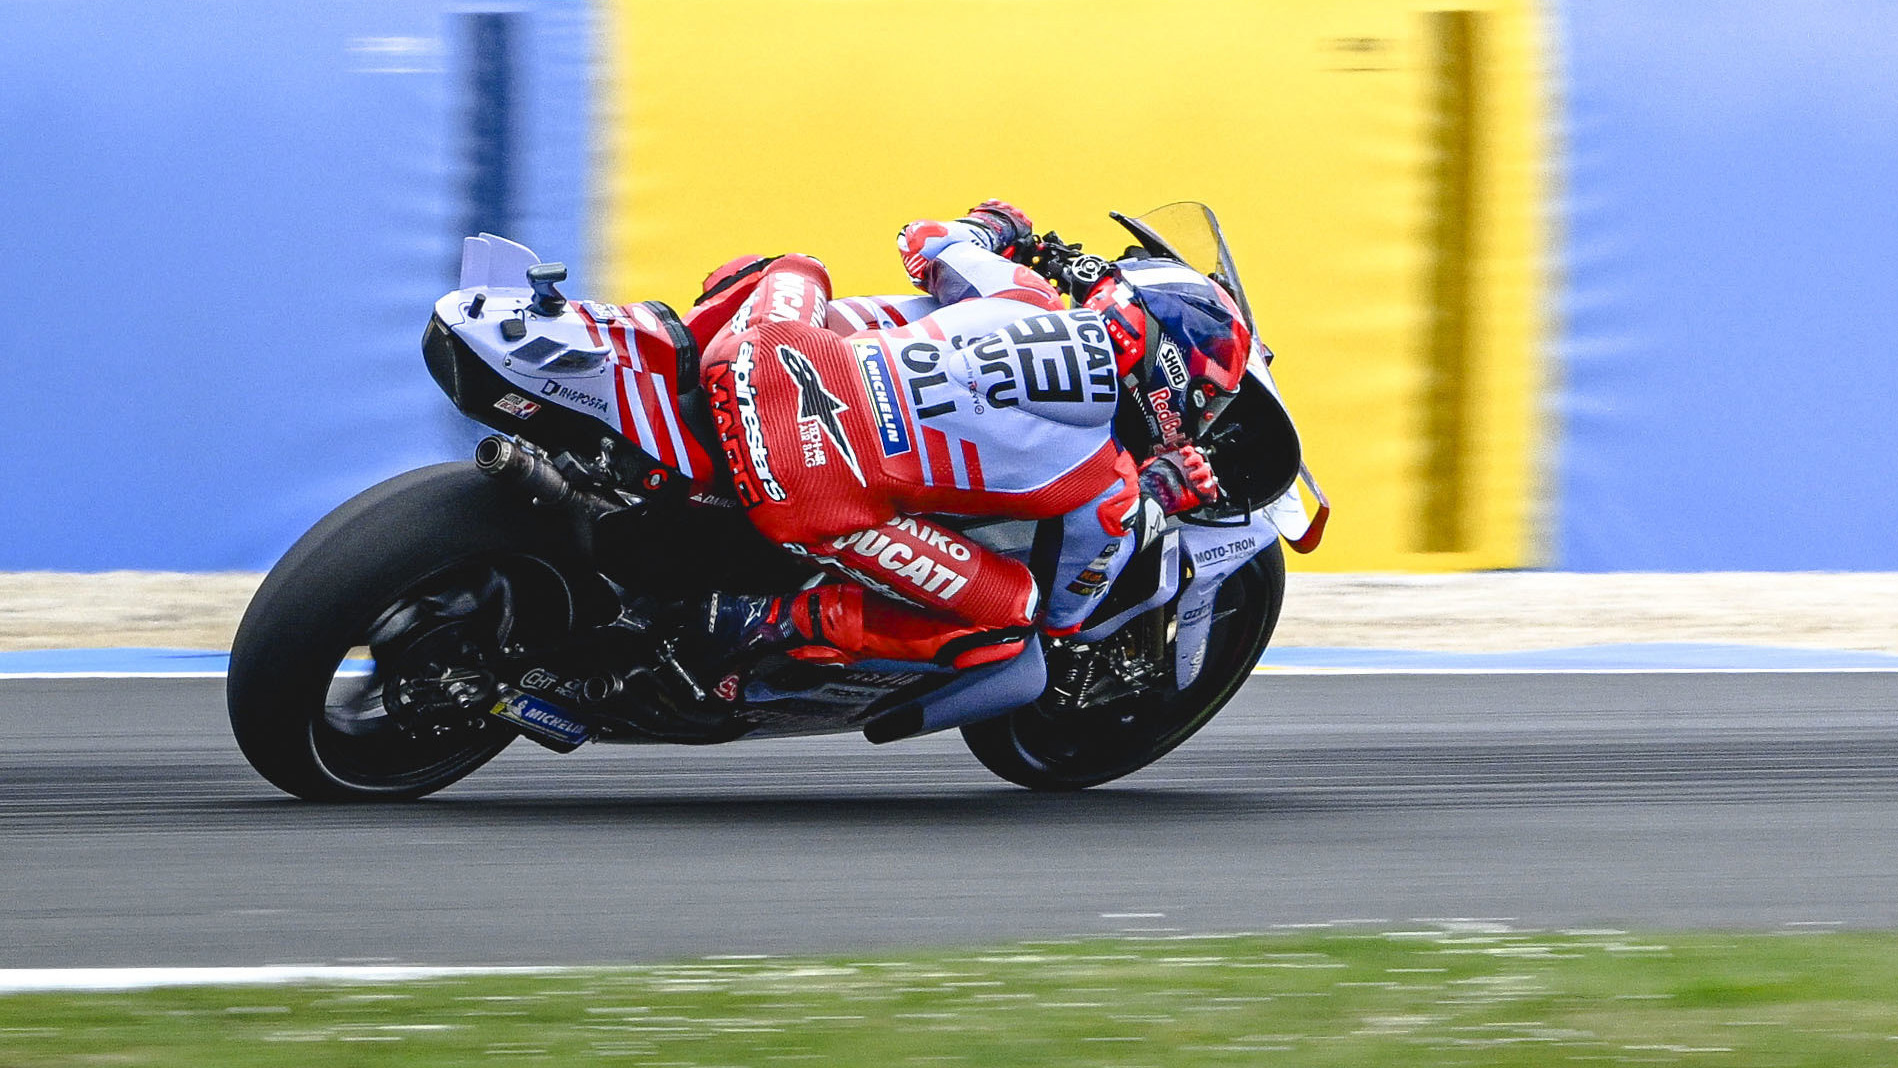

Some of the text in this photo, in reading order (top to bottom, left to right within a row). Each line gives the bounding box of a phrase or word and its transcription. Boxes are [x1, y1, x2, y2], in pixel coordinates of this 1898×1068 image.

[901, 342, 957, 420] OLI
[1070, 311, 1116, 403] UCATI
[1161, 348, 1187, 386] SHOEI
[730, 341, 788, 502] alpinestars
[865, 360, 900, 442] MICHELIN
[798, 423, 815, 468] AIR BAG
[1193, 536, 1256, 564] MOTO-TRON
[525, 708, 589, 734] MICHELIN
